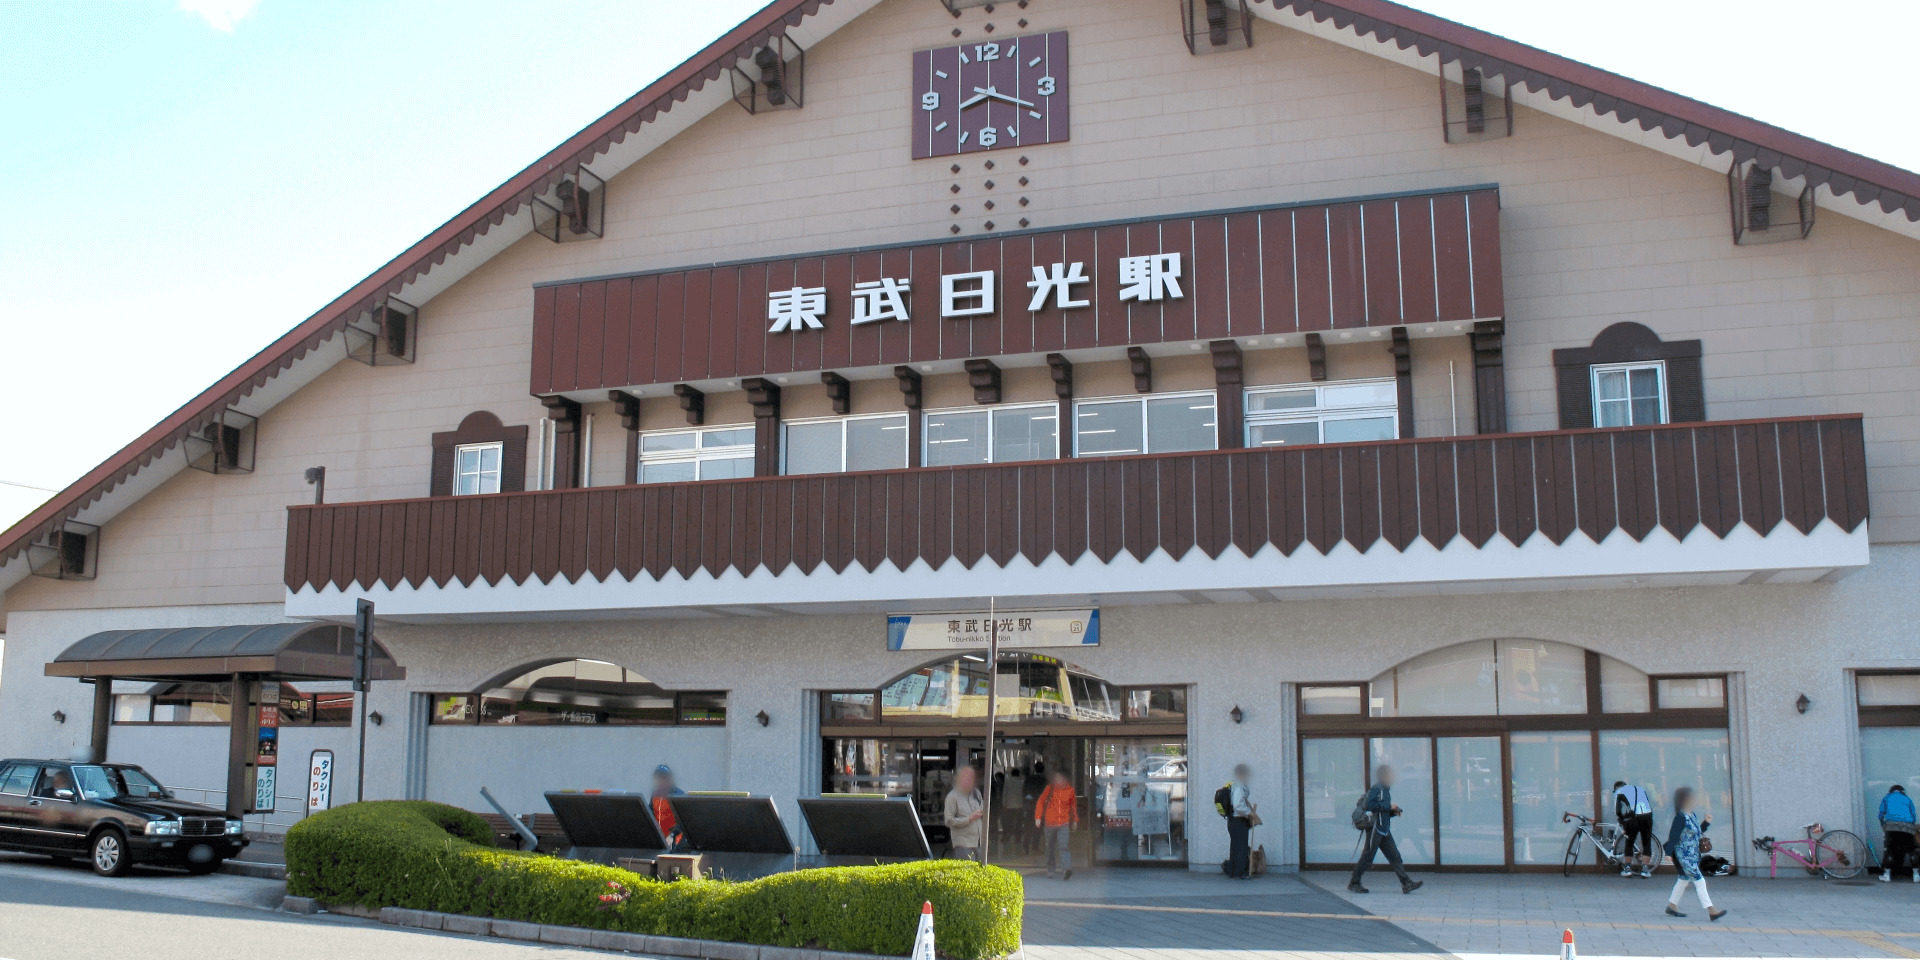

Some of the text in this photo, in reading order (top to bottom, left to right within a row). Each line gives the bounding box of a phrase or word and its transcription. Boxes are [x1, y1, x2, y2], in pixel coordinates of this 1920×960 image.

[975, 43, 1000, 62] 12
[1037, 76, 1056, 96] 3
[922, 91, 940, 111] 9
[979, 127, 997, 147] 6
[768, 252, 1184, 333] 東武日光駅
[947, 618, 1032, 633] 東武日光駅
[985, 634, 1011, 642] Stion
[265, 768, 273, 807] タクシー
[311, 767, 321, 806] のりば
[320, 760, 330, 801] タクシー
[257, 779, 265, 808] のりば
